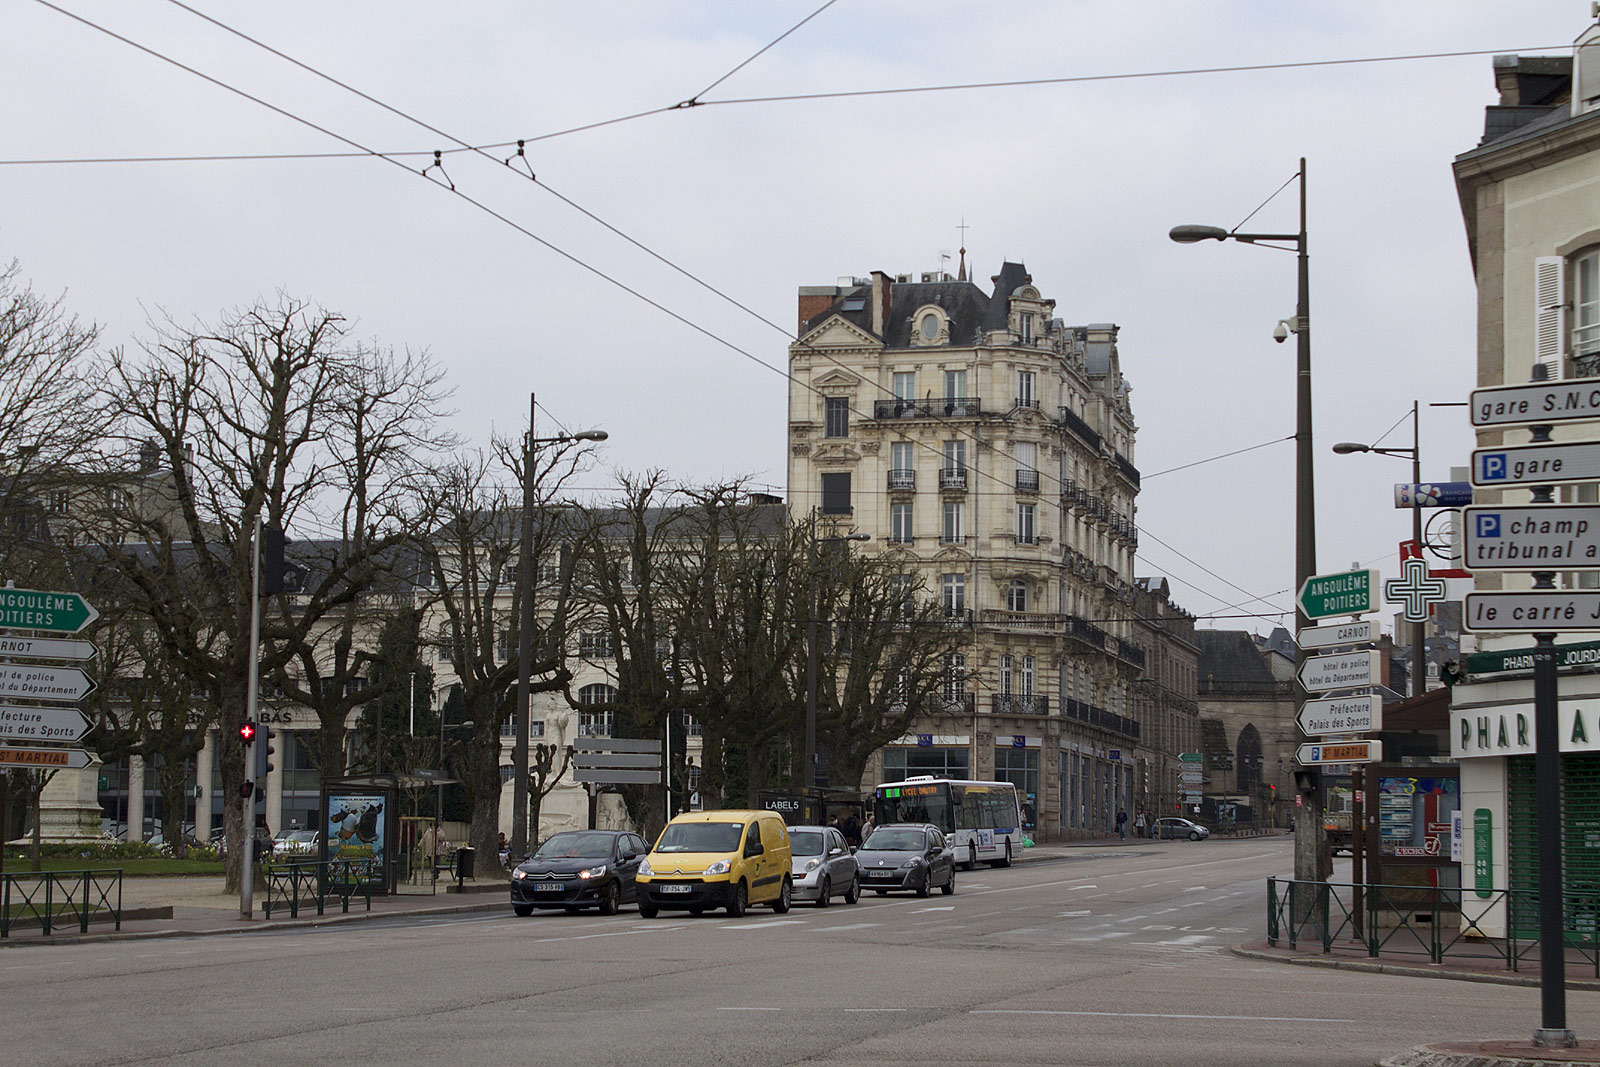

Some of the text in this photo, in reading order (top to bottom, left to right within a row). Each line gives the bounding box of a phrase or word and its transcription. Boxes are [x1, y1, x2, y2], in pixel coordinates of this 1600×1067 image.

[1481, 400, 1529, 421] gare
[1514, 459, 1562, 479] gare
[1510, 516, 1588, 538] champ
[1477, 540, 1573, 559] tribunal
[1323, 592, 1368, 612] POITIERS
[1476, 602, 1498, 621] le
[1512, 602, 1576, 621] carré
[1337, 626, 1369, 640] CARNOT
[11, 671, 22, 680] de
[26, 673, 55, 682] police
[8, 682, 19, 691] du
[22, 683, 78, 695] Département
[1330, 703, 1369, 715] Préfecture
[1309, 716, 1370, 730] Palais des Sports
[17, 724, 36, 734] des
[40, 725, 75, 738] Sports
[15, 752, 68, 764] MARTIAL
[1333, 746, 1368, 758] MARTIAL
